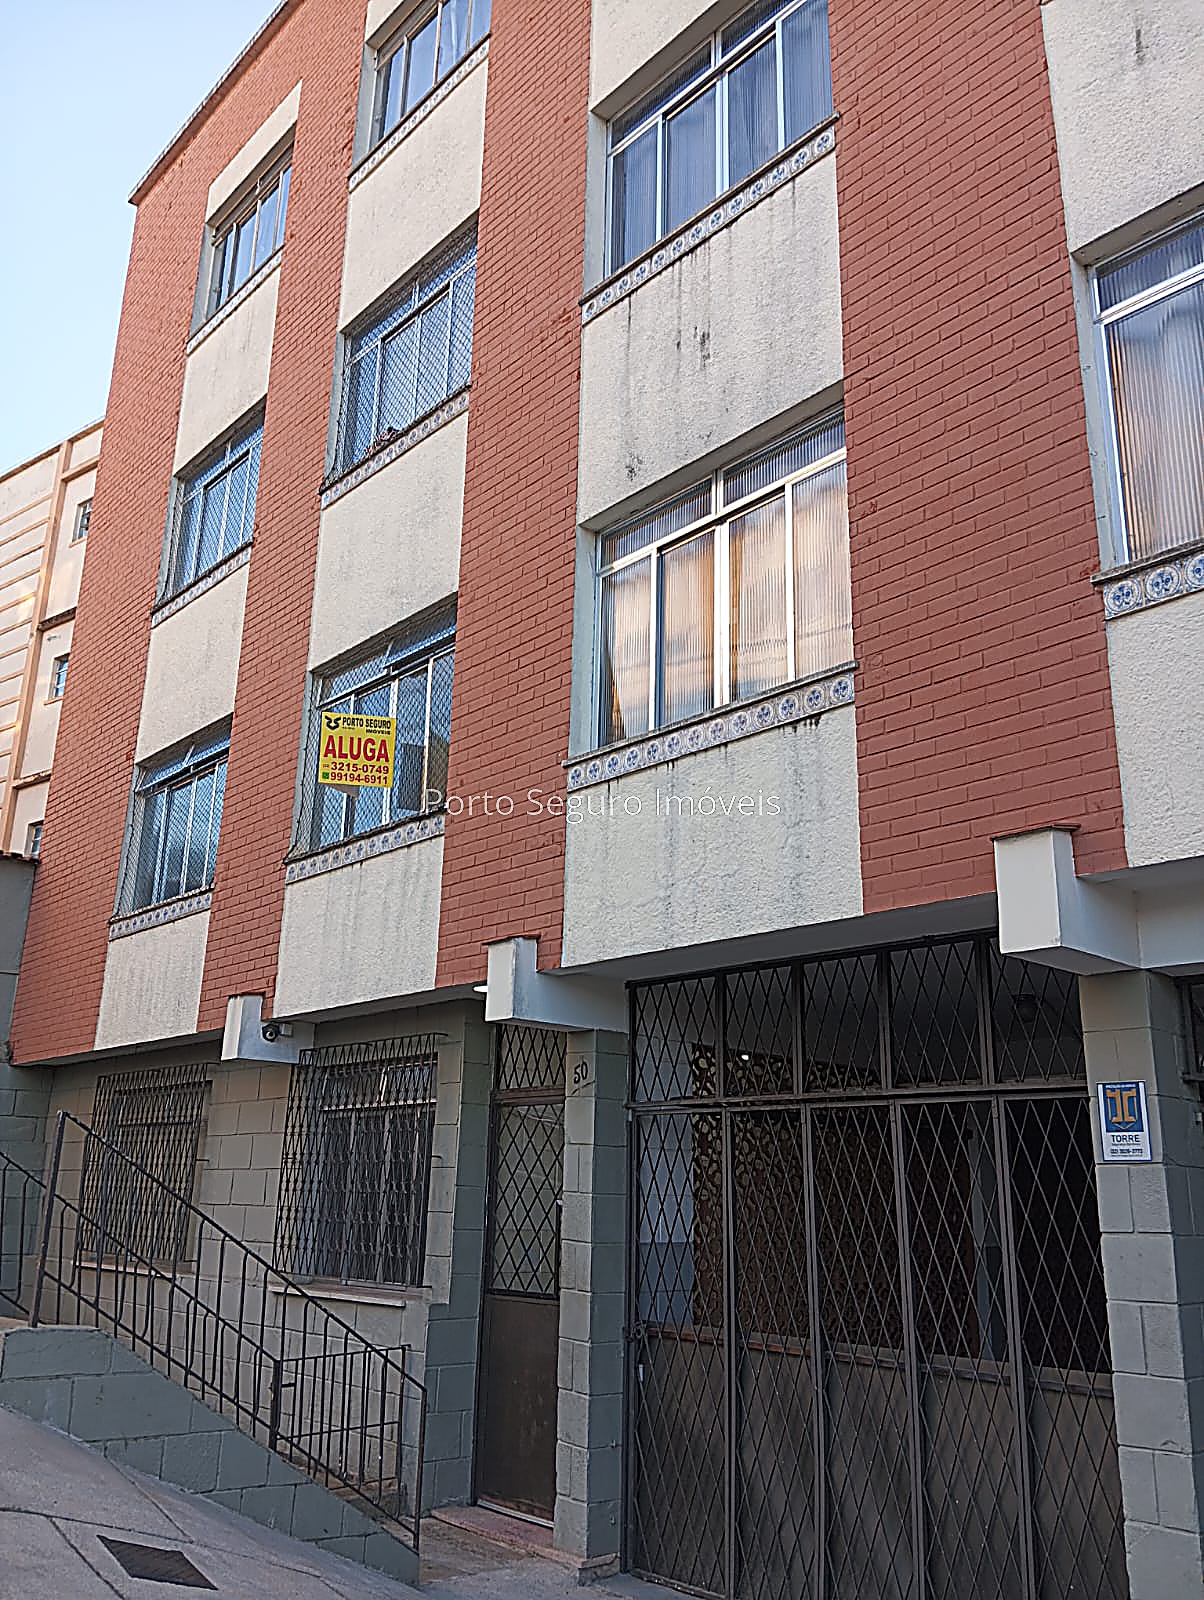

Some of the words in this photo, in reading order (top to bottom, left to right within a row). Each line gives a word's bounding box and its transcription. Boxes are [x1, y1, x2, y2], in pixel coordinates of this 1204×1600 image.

[342, 717, 364, 727] PORTO
[365, 719, 391, 729] SEGURO
[323, 735, 389, 762] ALUGA
[331, 762, 389, 774] 3215-0749
[330, 772, 388, 784] 99194-6911
[574, 1061, 588, 1084] 50
[1111, 1134, 1140, 1142] TORRE
